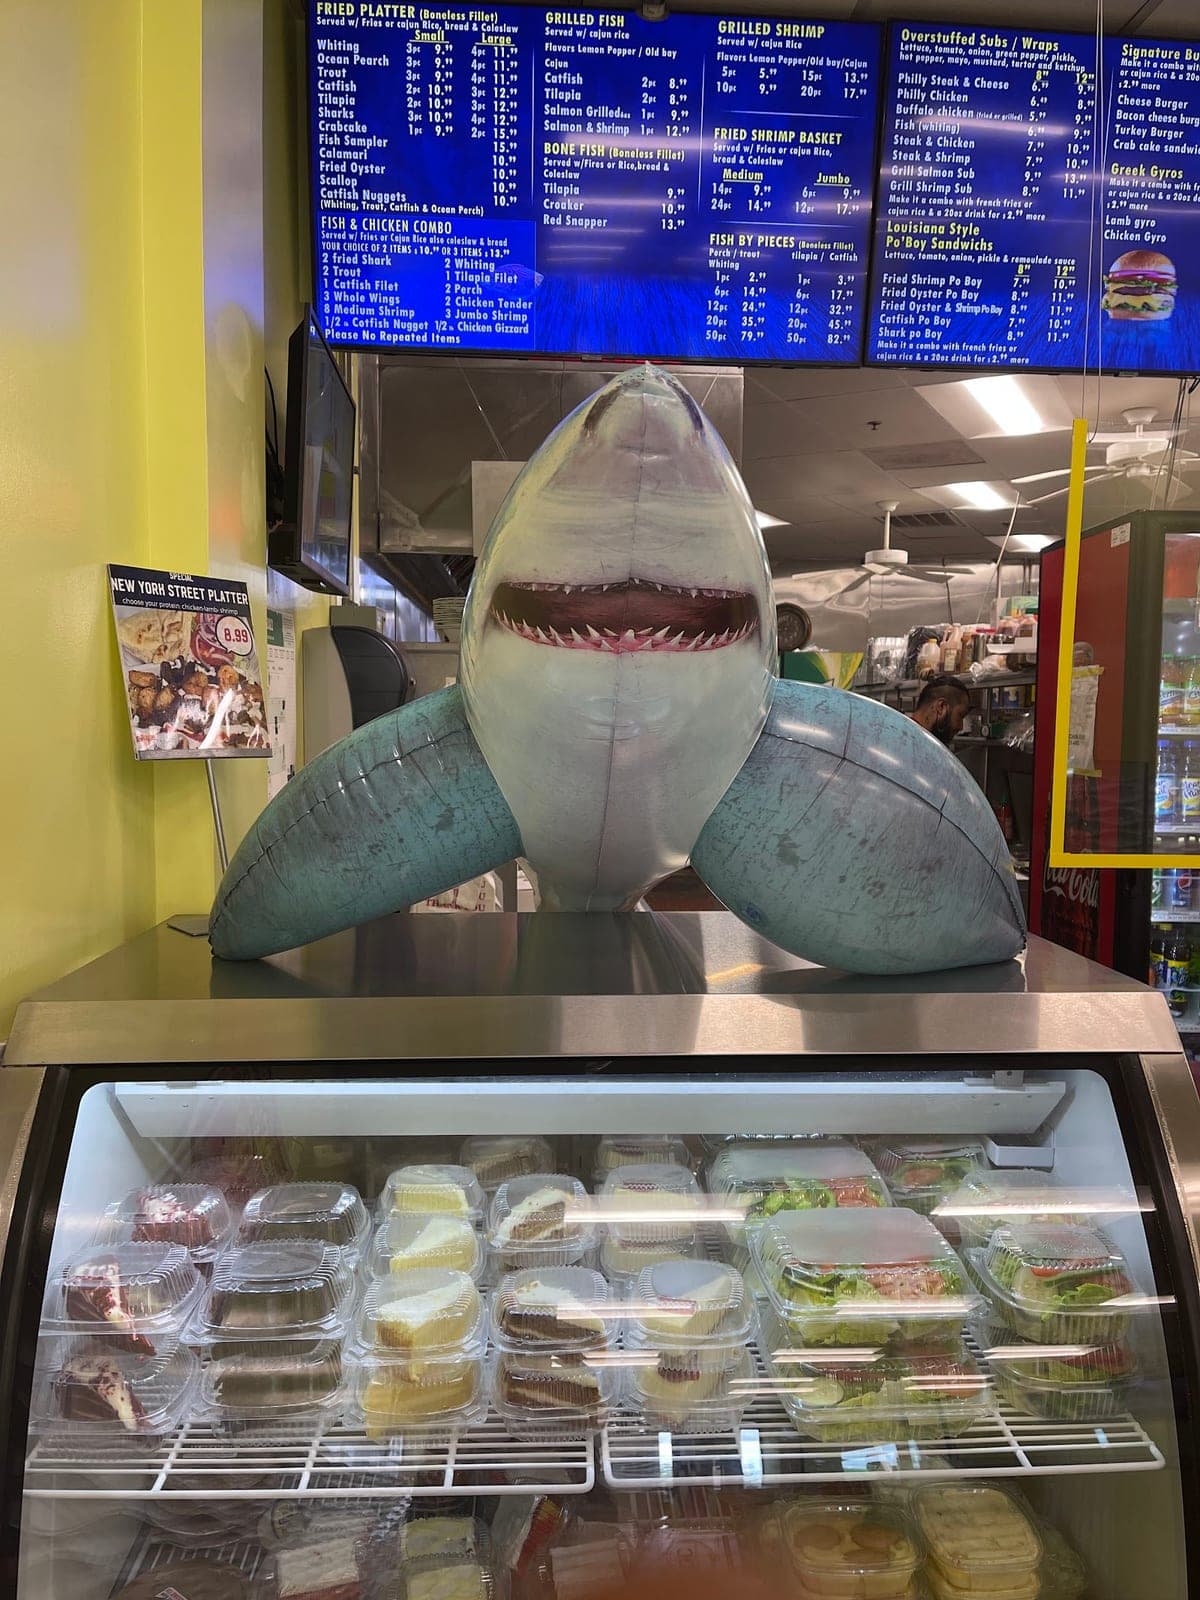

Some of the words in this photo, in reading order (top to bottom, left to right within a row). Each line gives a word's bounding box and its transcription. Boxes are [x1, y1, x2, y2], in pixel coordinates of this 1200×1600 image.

[317, 3, 354, 15] FRIED
[360, 4, 415, 18] PLATTER
[420, 9, 465, 21] (Boneless
[469, 11, 497, 23] Fillet)
[546, 13, 594, 25] GRILLED
[599, 15, 624, 26] FISH
[317, 18, 345, 26] Served
[445, 22, 469, 31] bread
[472, 23, 478, 31] &
[481, 23, 518, 33] Coleslaw
[719, 21, 770, 35] GRILLED
[776, 24, 825, 38] SHRIMP
[415, 30, 445, 41] Small
[482, 33, 511, 44] Large
[902, 29, 975, 46] Overstuffed
[980, 35, 1008, 47] Subs
[1022, 38, 1059, 51] Wraps
[318, 40, 359, 53] Whiting
[318, 54, 349, 64] Ocean
[354, 55, 389, 66] Pearch
[318, 67, 347, 78] Trout
[545, 73, 583, 84] Catfish
[318, 81, 357, 91] Catfish
[898, 73, 927, 86] Philly
[931, 75, 960, 86] Steak
[964, 76, 970, 87] &
[975, 77, 1009, 90] Cheese
[318, 94, 355, 106] Tilapia
[545, 89, 581, 101] Tilapia
[897, 89, 926, 102] Philly
[930, 91, 968, 102] Chicken
[1118, 95, 1152, 107] Cheese
[1155, 97, 1188, 110] Burger
[319, 107, 354, 119] Sharks
[319, 121, 367, 133] Crabcake
[544, 120, 582, 132] Salmon
[587, 122, 593, 132] &
[597, 122, 629, 136] Shrimp
[895, 120, 915, 130] Fish
[919, 121, 960, 134] (whiting)
[319, 134, 340, 145] Fish
[344, 135, 388, 149] Sampler
[714, 128, 747, 140] FRIED
[752, 130, 795, 143] SHRIMP
[799, 132, 842, 144] BASKET
[894, 135, 923, 146] Steak
[926, 137, 933, 147] &
[937, 137, 975, 149] Chicken
[320, 148, 367, 160] Calamari
[544, 143, 575, 155] BONE
[580, 144, 605, 156] FISH
[320, 161, 347, 172] Fried
[351, 162, 385, 175] Oyster
[892, 166, 914, 177] Grill
[917, 167, 953, 178] Salmon
[957, 168, 975, 179] Sub
[1112, 163, 1145, 177] Greek
[1150, 165, 1183, 180] Gyros
[320, 175, 357, 187] Scallop
[723, 169, 763, 181] Medium
[817, 173, 850, 184] Jumbo
[544, 183, 580, 195] Tilapia
[890, 181, 913, 191] Grill
[916, 182, 951, 195] Shrimp
[955, 183, 972, 194] Sub
[321, 188, 359, 200] Catfish
[363, 190, 406, 203] Nuggets
[390, 203, 419, 212] Catfish
[423, 204, 428, 212] &
[432, 205, 456, 213] Ocean
[459, 206, 484, 216] Perch)
[544, 199, 584, 210] Croaker
[322, 217, 346, 229] FISH
[351, 219, 358, 230] &
[362, 218, 409, 232] CHICKEN
[414, 220, 452, 234] COMBO
[544, 215, 562, 225] Red
[566, 215, 607, 228] Snapper
[1106, 215, 1131, 226] Lamb
[1134, 218, 1156, 229] gyro
[887, 221, 945, 234] Louisiana
[949, 224, 980, 236] Style
[710, 234, 734, 245] FISH
[739, 235, 753, 246] BY
[758, 236, 795, 248] PIECES
[1105, 230, 1141, 241] Chicken
[1144, 231, 1166, 243] Gyro
[886, 236, 927, 251] Po'Boy
[931, 238, 993, 251] Sandwichs
[322, 253, 328, 263] 2
[333, 254, 358, 265] fried
[362, 255, 392, 265] Shark
[709, 248, 730, 257] Perch
[792, 252, 818, 261] tilapia
[830, 253, 858, 261] Catfish
[445, 259, 451, 268] 2
[455, 259, 495, 271] Whiting
[709, 260, 740, 269] Whiting
[323, 267, 329, 276] 2
[333, 266, 361, 277] Trout
[446, 271, 450, 281] 1
[455, 272, 490, 285] Tilapia
[494, 272, 518, 283] Filet
[324, 279, 328, 289] 1
[334, 279, 370, 290] Catfish
[375, 280, 399, 291] Filet
[883, 273, 907, 284] Fried
[911, 274, 945, 287] Shrimp
[949, 276, 961, 286] Po
[964, 276, 982, 288] Boy
[445, 284, 451, 294] 2
[455, 284, 482, 295] Perch
[324, 292, 329, 301] 3
[334, 292, 365, 302] Whole
[369, 293, 400, 304] Wings
[445, 297, 451, 306] 2
[455, 297, 494, 307] Chicken
[498, 298, 532, 309] Tender
[324, 304, 330, 314] 8
[334, 304, 375, 315] Medium
[379, 306, 415, 318] Shrimp
[445, 309, 451, 319] 3
[455, 309, 488, 320] Jumbo
[492, 310, 527, 323] Shrimp
[325, 329, 358, 340] Please
[363, 331, 376, 341] No
[380, 331, 427, 343] Repeated
[432, 332, 460, 343] Items
[111, 578, 135, 592] NEW
[138, 580, 165, 595] YORK
[168, 585, 205, 600] STREET
[209, 590, 248, 605] PLATTER
[224, 628, 249, 643] 8.99
